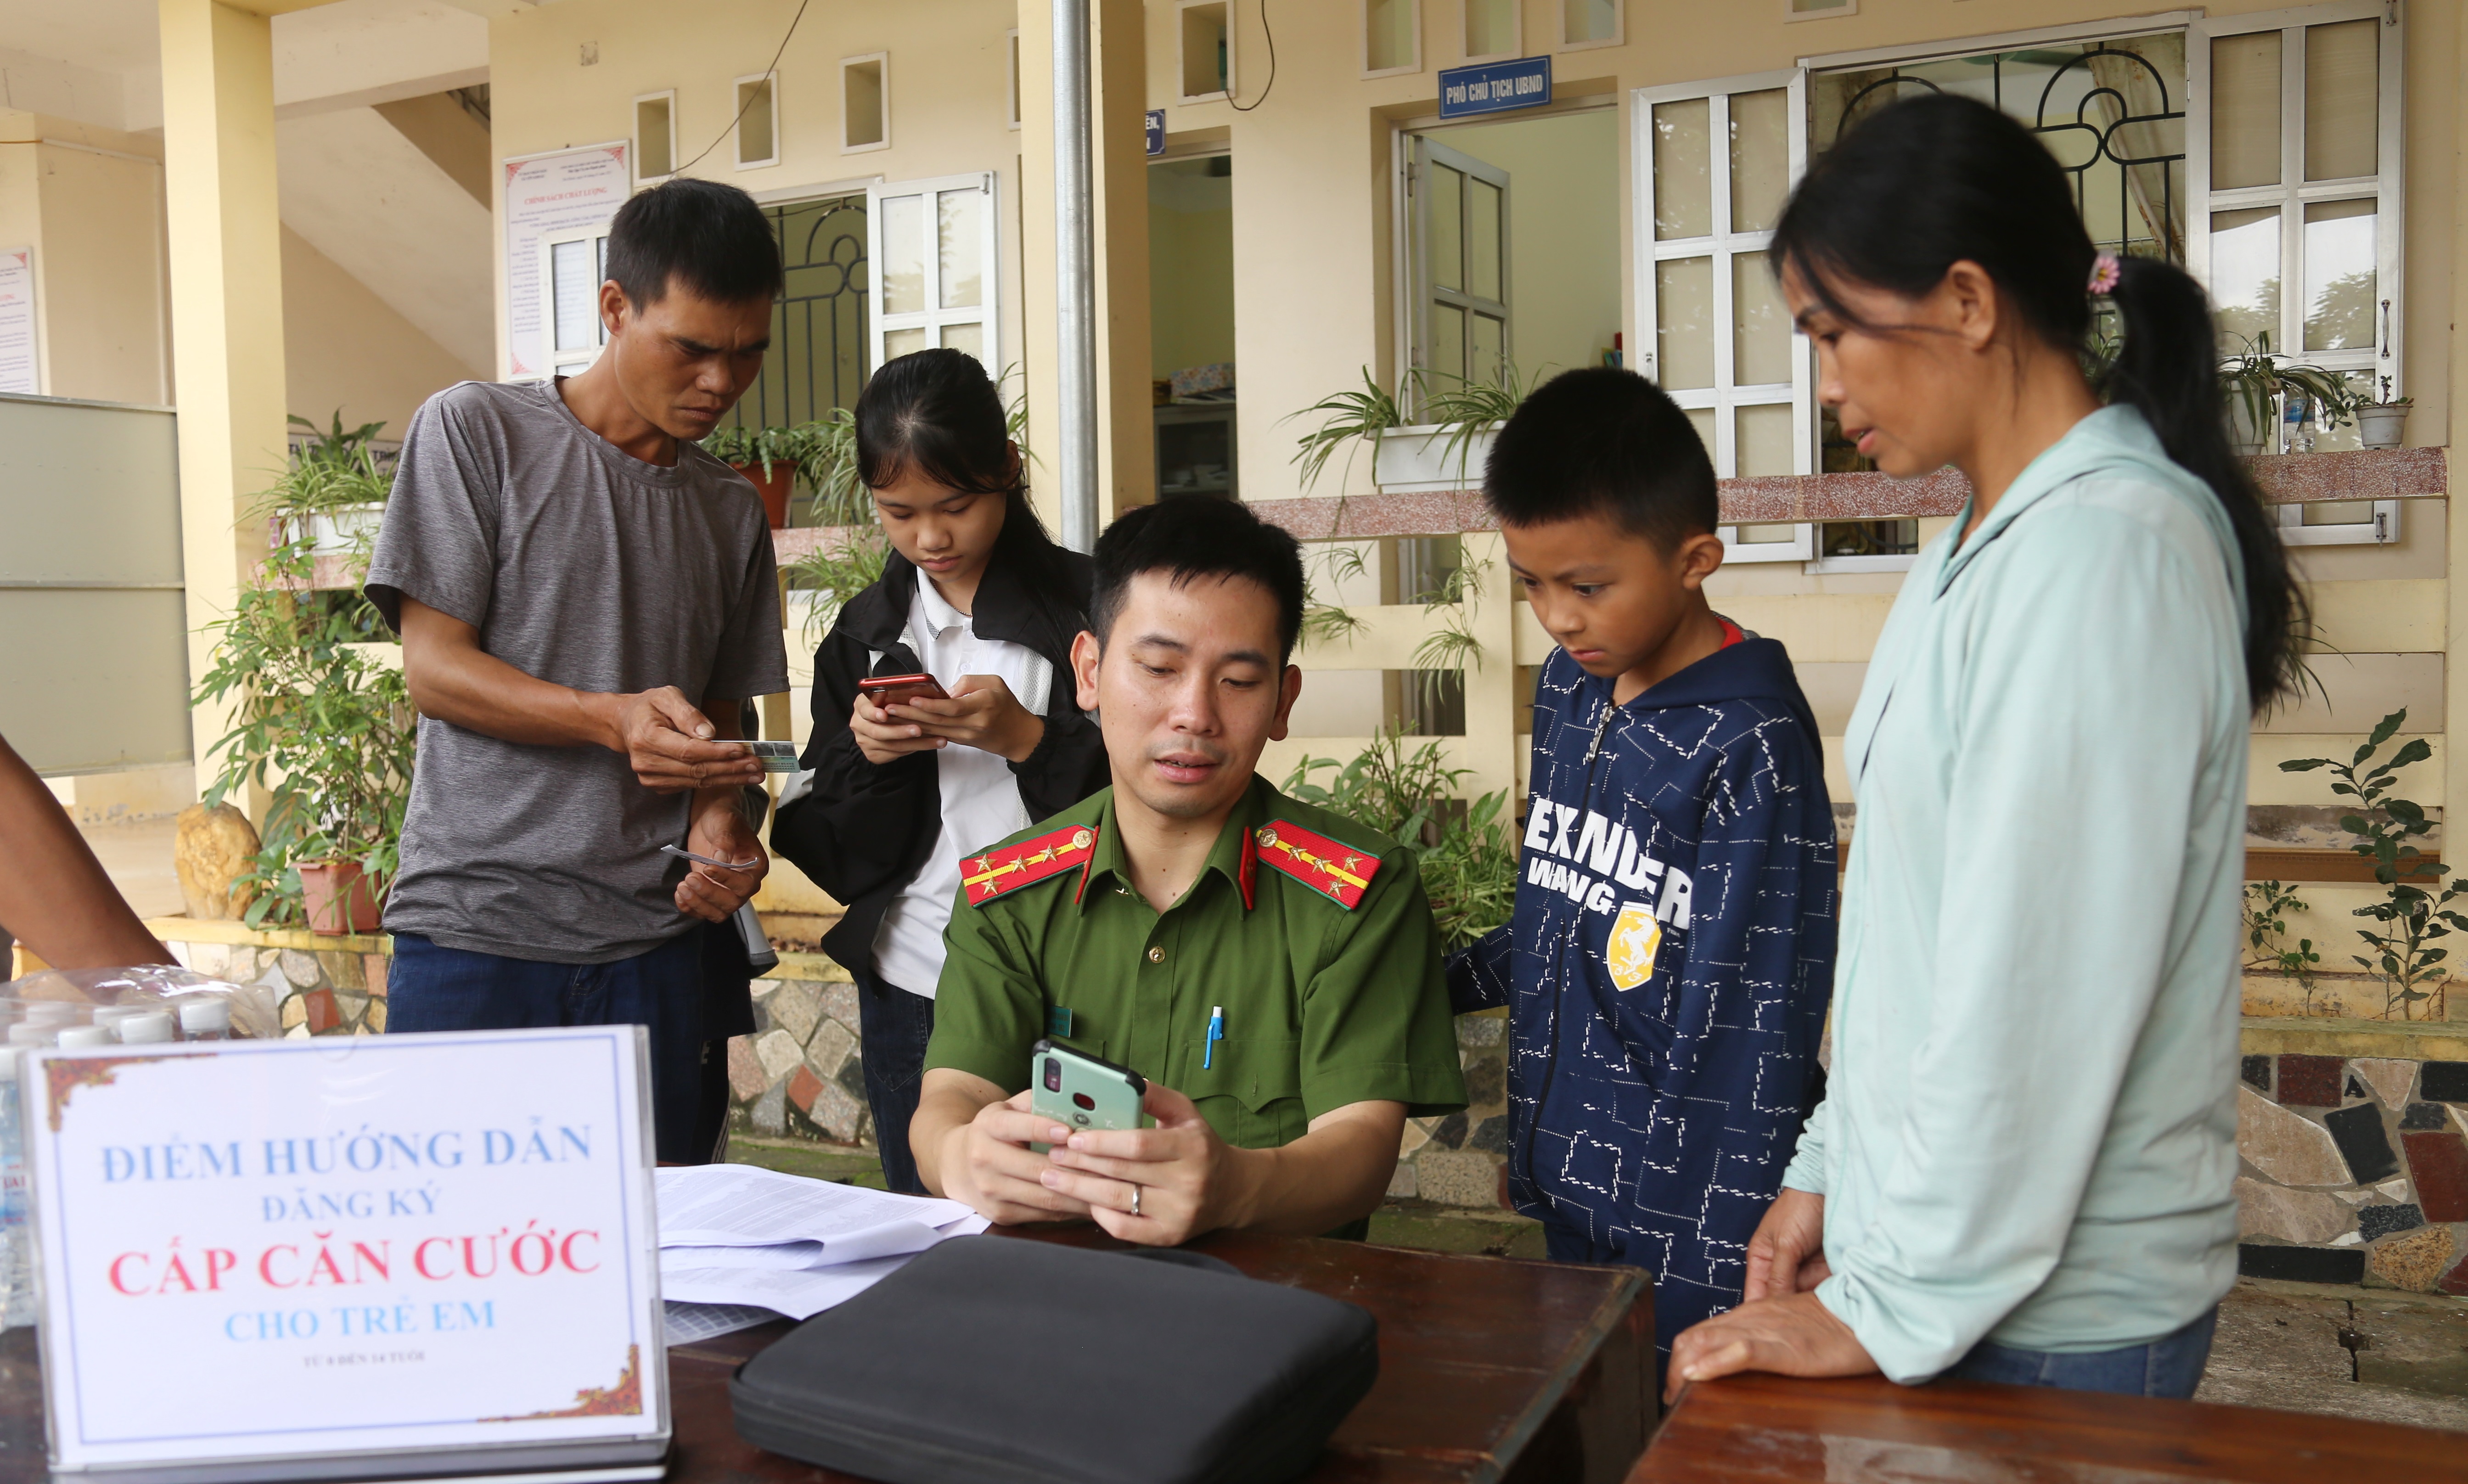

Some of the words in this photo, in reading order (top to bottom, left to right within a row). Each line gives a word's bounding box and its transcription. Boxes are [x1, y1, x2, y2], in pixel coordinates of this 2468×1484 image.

[1446, 81, 1467, 105] PHÓ
[1468, 74, 1489, 102] CHỦ
[1490, 79, 1513, 102] TỊCH
[1515, 74, 1543, 96] UBND
[1527, 857, 1616, 916] WANG
[102, 1132, 242, 1183] ĐIỂM
[264, 1123, 463, 1176] HƯỚNG
[482, 1116, 593, 1166] DẪN
[262, 1190, 374, 1222] ĐĂNG
[388, 1182, 442, 1217] KÝ
[107, 1236, 237, 1297] CẤP
[258, 1231, 390, 1289] CĂN
[412, 1219, 600, 1281] CƯỚC
[224, 1311, 320, 1341] CHO
[331, 1296, 418, 1336] TRẺ
[432, 1300, 495, 1331] EM
